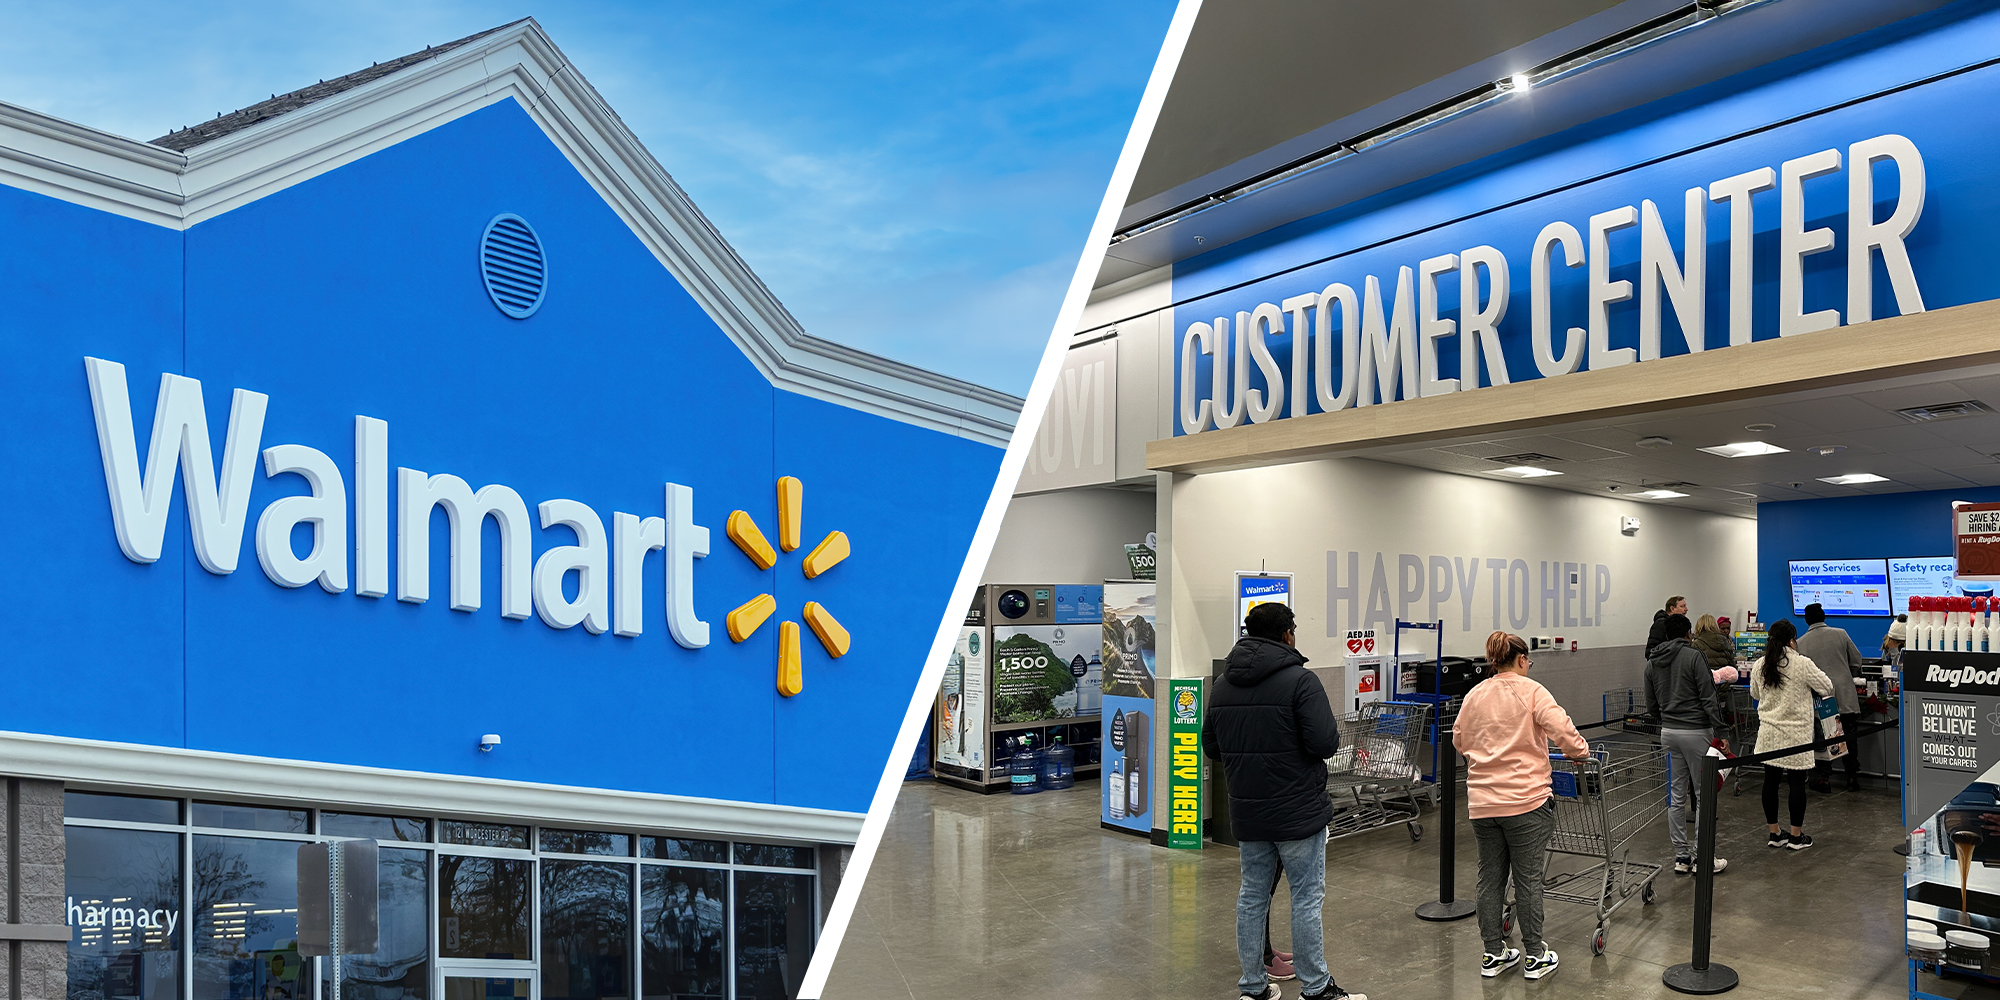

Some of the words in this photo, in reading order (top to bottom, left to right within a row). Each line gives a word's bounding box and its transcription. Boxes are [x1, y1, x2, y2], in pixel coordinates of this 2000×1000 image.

[1180, 243, 1512, 436] CUSTOMER
[1530, 134, 1926, 378] CENTER
[84, 356, 710, 650] Walmart
[1969, 513, 1988, 523] SAVE
[1969, 522, 1997, 533] HIRING
[1131, 555, 1155, 569] 1,500
[1791, 564, 1820, 574] Money
[1822, 563, 1861, 572] Services
[1893, 563, 1927, 574] Safety
[1245, 585, 1275, 594] Walmart
[1326, 550, 1479, 637] HAPPY
[1486, 558, 1530, 630] TO
[1541, 561, 1611, 629] HELP
[1347, 631, 1363, 639] AED
[1364, 630, 1375, 638] AED
[1000, 656, 1049, 673] 1,500
[1922, 703, 1941, 716] YOU
[1943, 704, 1976, 718] WON'T
[1922, 716, 1976, 736] BELIEVE
[1934, 734, 1966, 744] WHAT
[1173, 732, 1198, 780] PLAY
[1922, 742, 1956, 757] COMES
[1957, 745, 1977, 759] OUT
[1930, 756, 1948, 766] YOUR
[1948, 757, 1977, 769] CARPETS
[1173, 785, 1198, 835] HERE
[465, 828, 500, 842] WORCESTER
[64, 896, 179, 937] harmacy
